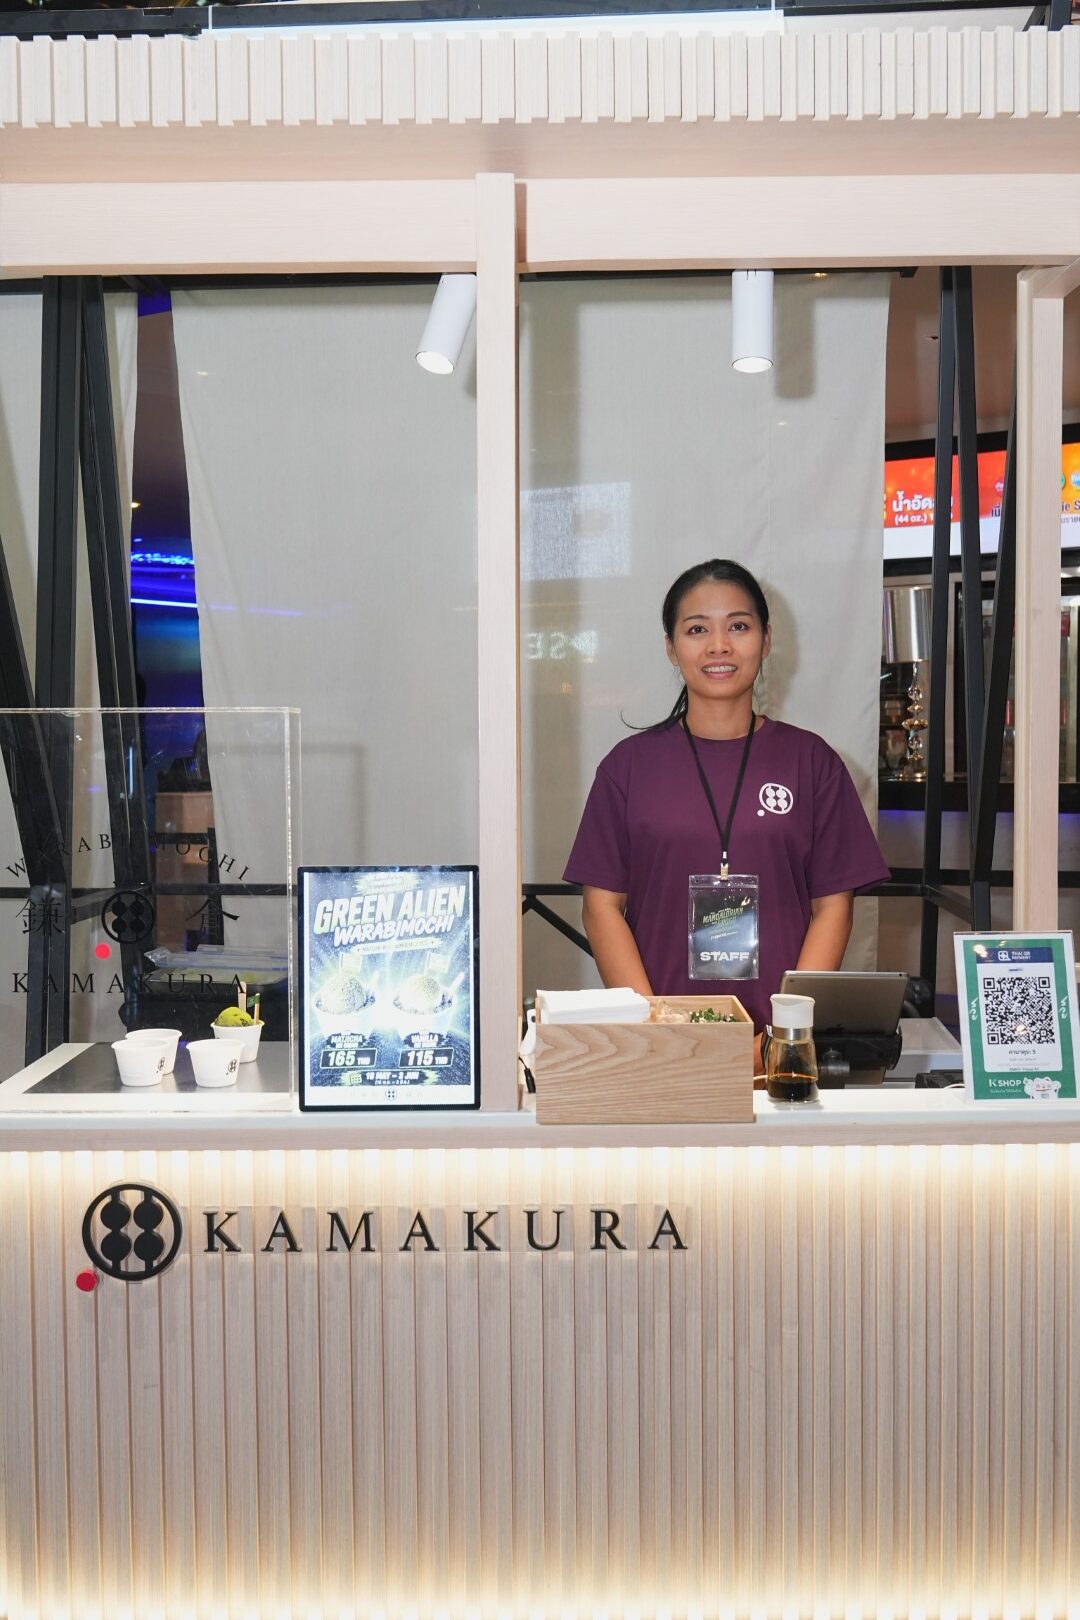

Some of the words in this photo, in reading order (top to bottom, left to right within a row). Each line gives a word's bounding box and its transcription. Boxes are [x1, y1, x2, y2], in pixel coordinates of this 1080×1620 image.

[314, 894, 395, 934] GREEN
[399, 886, 466, 918] ALIEN
[700, 951, 750, 962] STAFF
[12, 972, 247, 994] KAMAKURA
[328, 1050, 356, 1067] 165
[407, 1050, 434, 1066] 115
[203, 1208, 689, 1254] KAMAKURA
